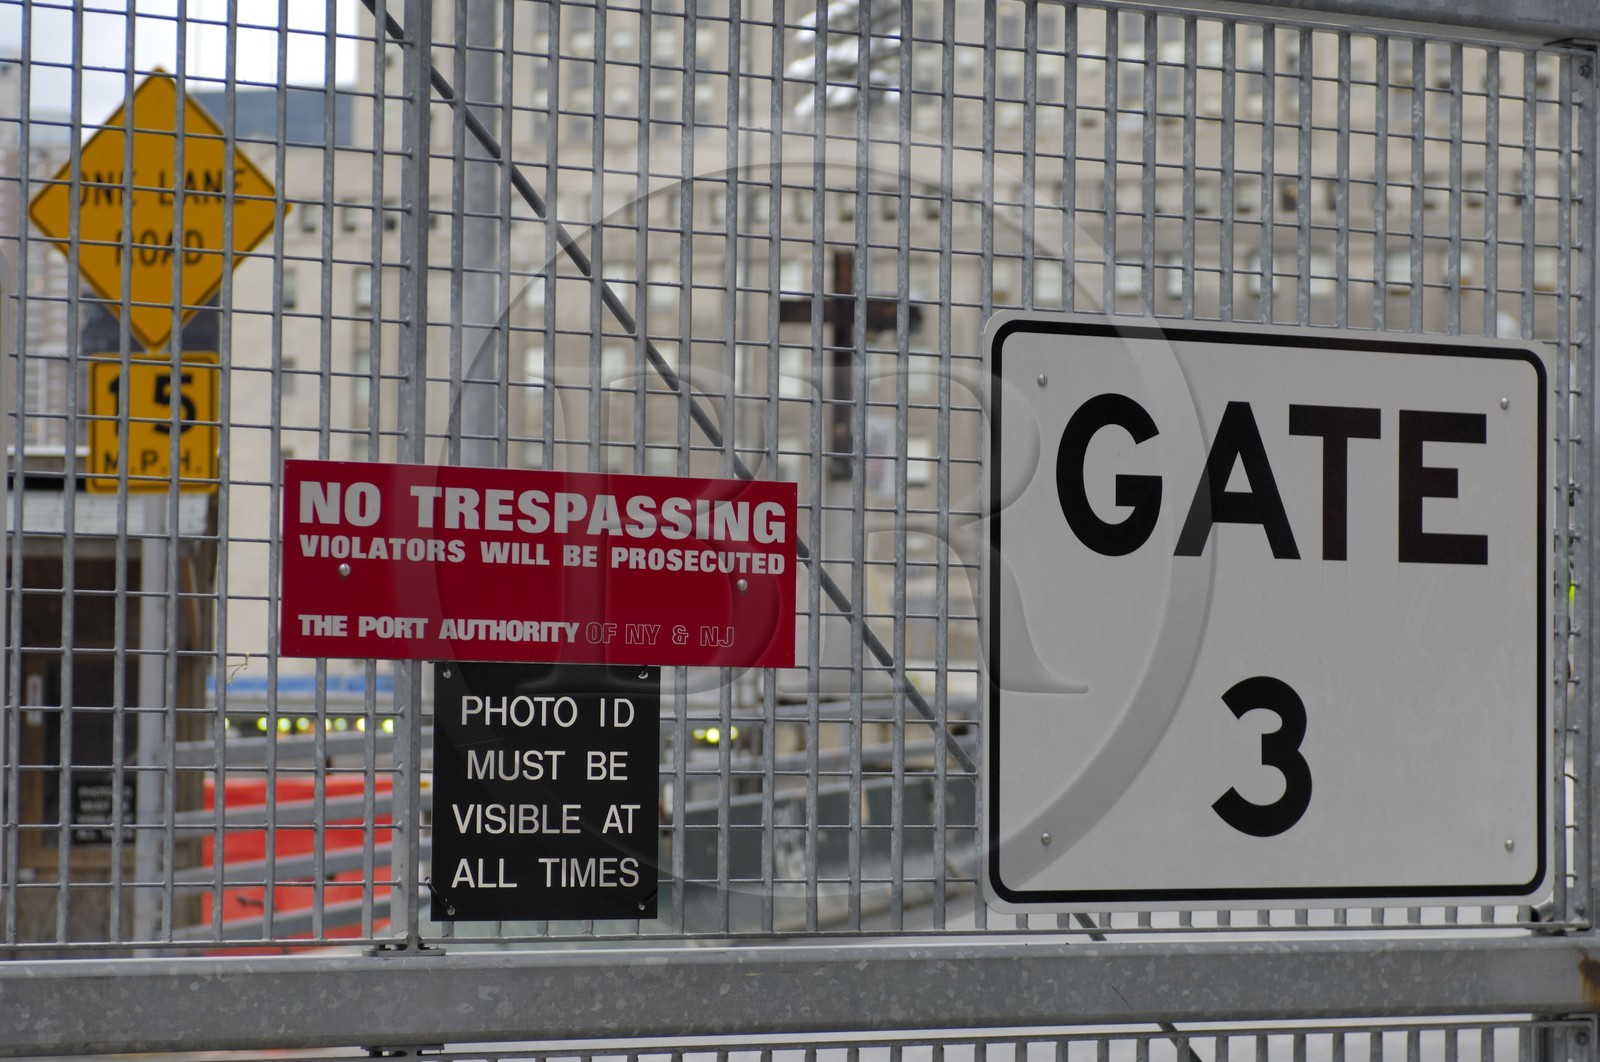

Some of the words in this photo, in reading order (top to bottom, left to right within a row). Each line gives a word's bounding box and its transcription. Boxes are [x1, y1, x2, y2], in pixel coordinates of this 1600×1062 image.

[158, 169, 247, 206] LANE
[108, 373, 197, 436] 15
[1055, 392, 1489, 566] GATE
[299, 480, 381, 527] NO
[410, 485, 787, 545] TRESPASSING
[298, 534, 466, 564] VIOLATORS
[480, 541, 551, 567] WILL
[563, 545, 598, 568] BE
[611, 547, 786, 576] PROSECUTED
[298, 613, 348, 638] THE
[358, 615, 429, 640] PORT
[438, 618, 580, 644] AUTHORITY
[585, 623, 617, 645] OF
[625, 624, 661, 645] NY
[672, 624, 689, 645] &
[700, 625, 736, 648] NJ
[461, 695, 578, 728] PHOTO
[599, 698, 635, 729] ID
[466, 749, 566, 782] MUST
[586, 751, 628, 782] BE
[1210, 675, 1313, 838] 3
[452, 803, 582, 835] VISIBLE
[601, 804, 641, 835] AT
[450, 857, 517, 889] ALL
[538, 857, 640, 889] TIMES
